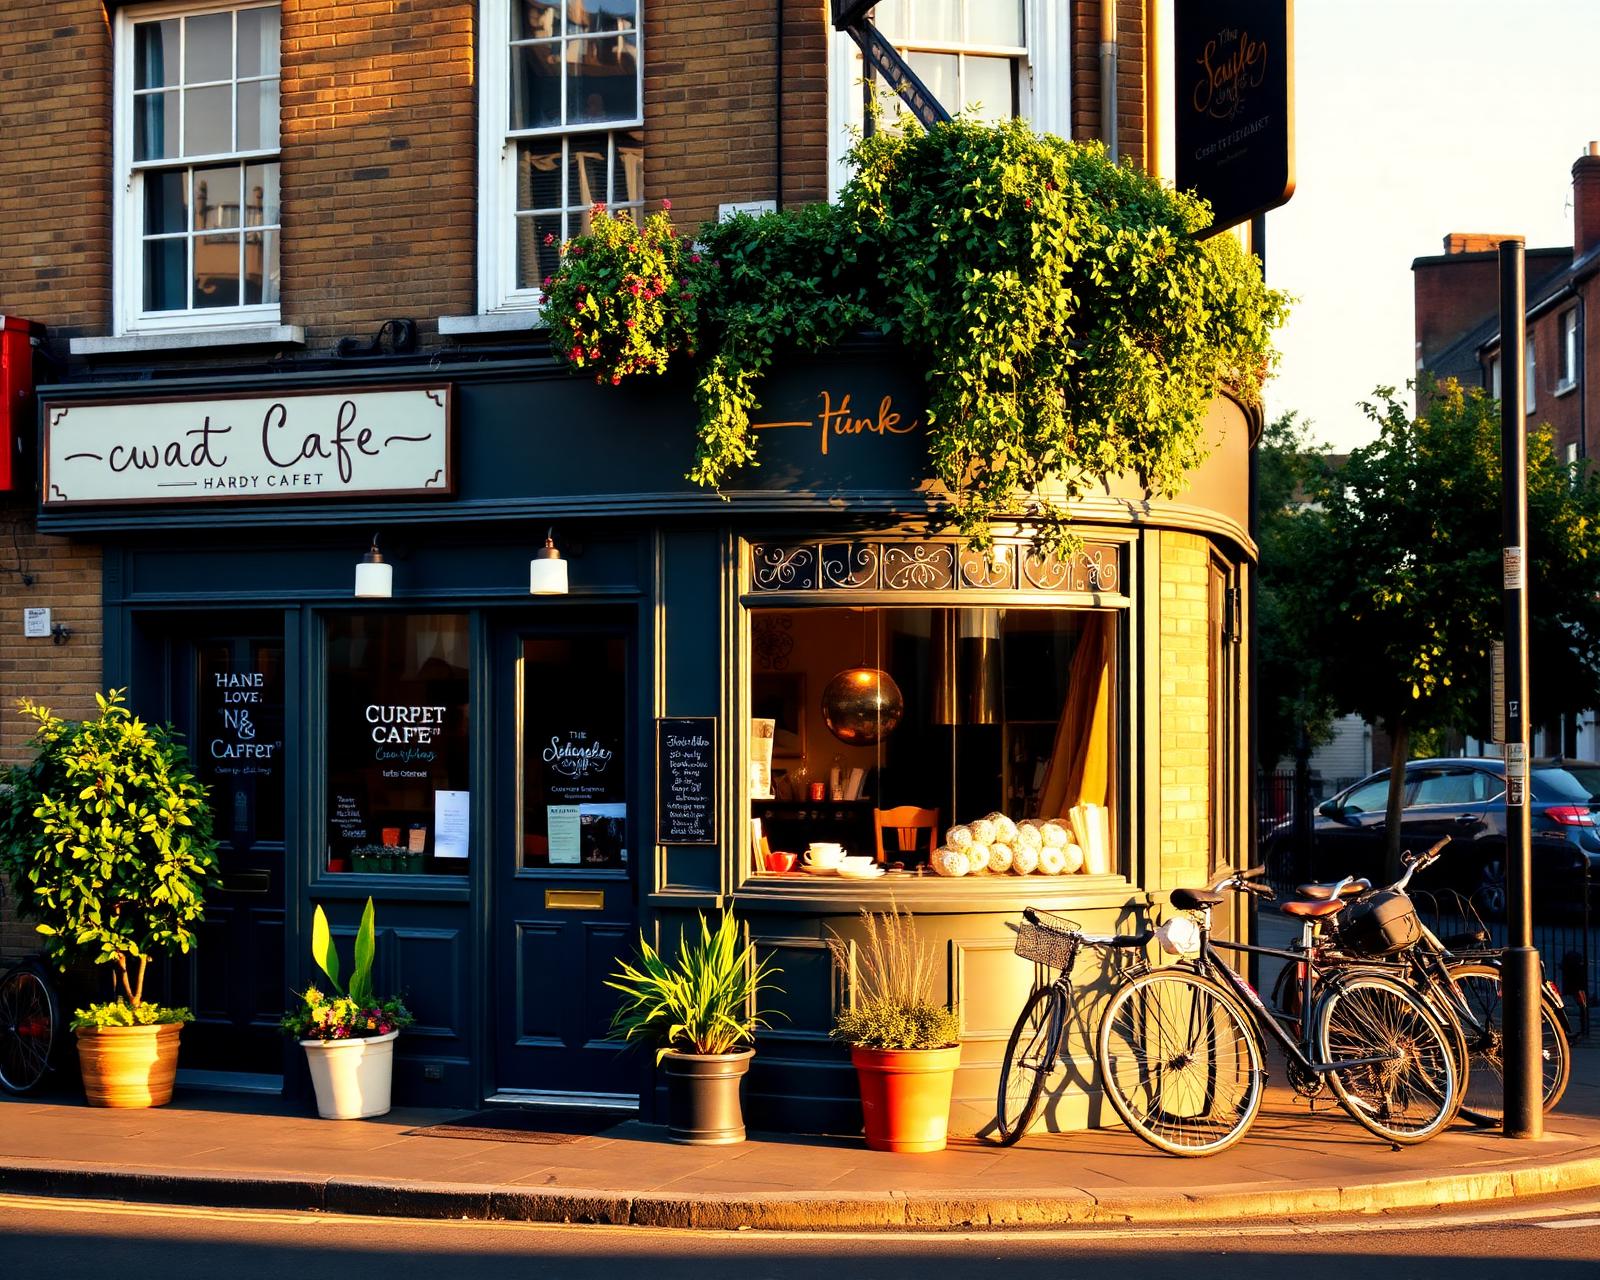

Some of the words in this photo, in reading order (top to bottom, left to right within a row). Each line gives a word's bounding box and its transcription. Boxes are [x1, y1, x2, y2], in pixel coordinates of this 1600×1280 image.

[262, 400, 380, 483] Cafe
[204, 476, 259, 489] HARDY
[267, 473, 324, 487] CAFET
[215, 672, 264, 687] HANE
